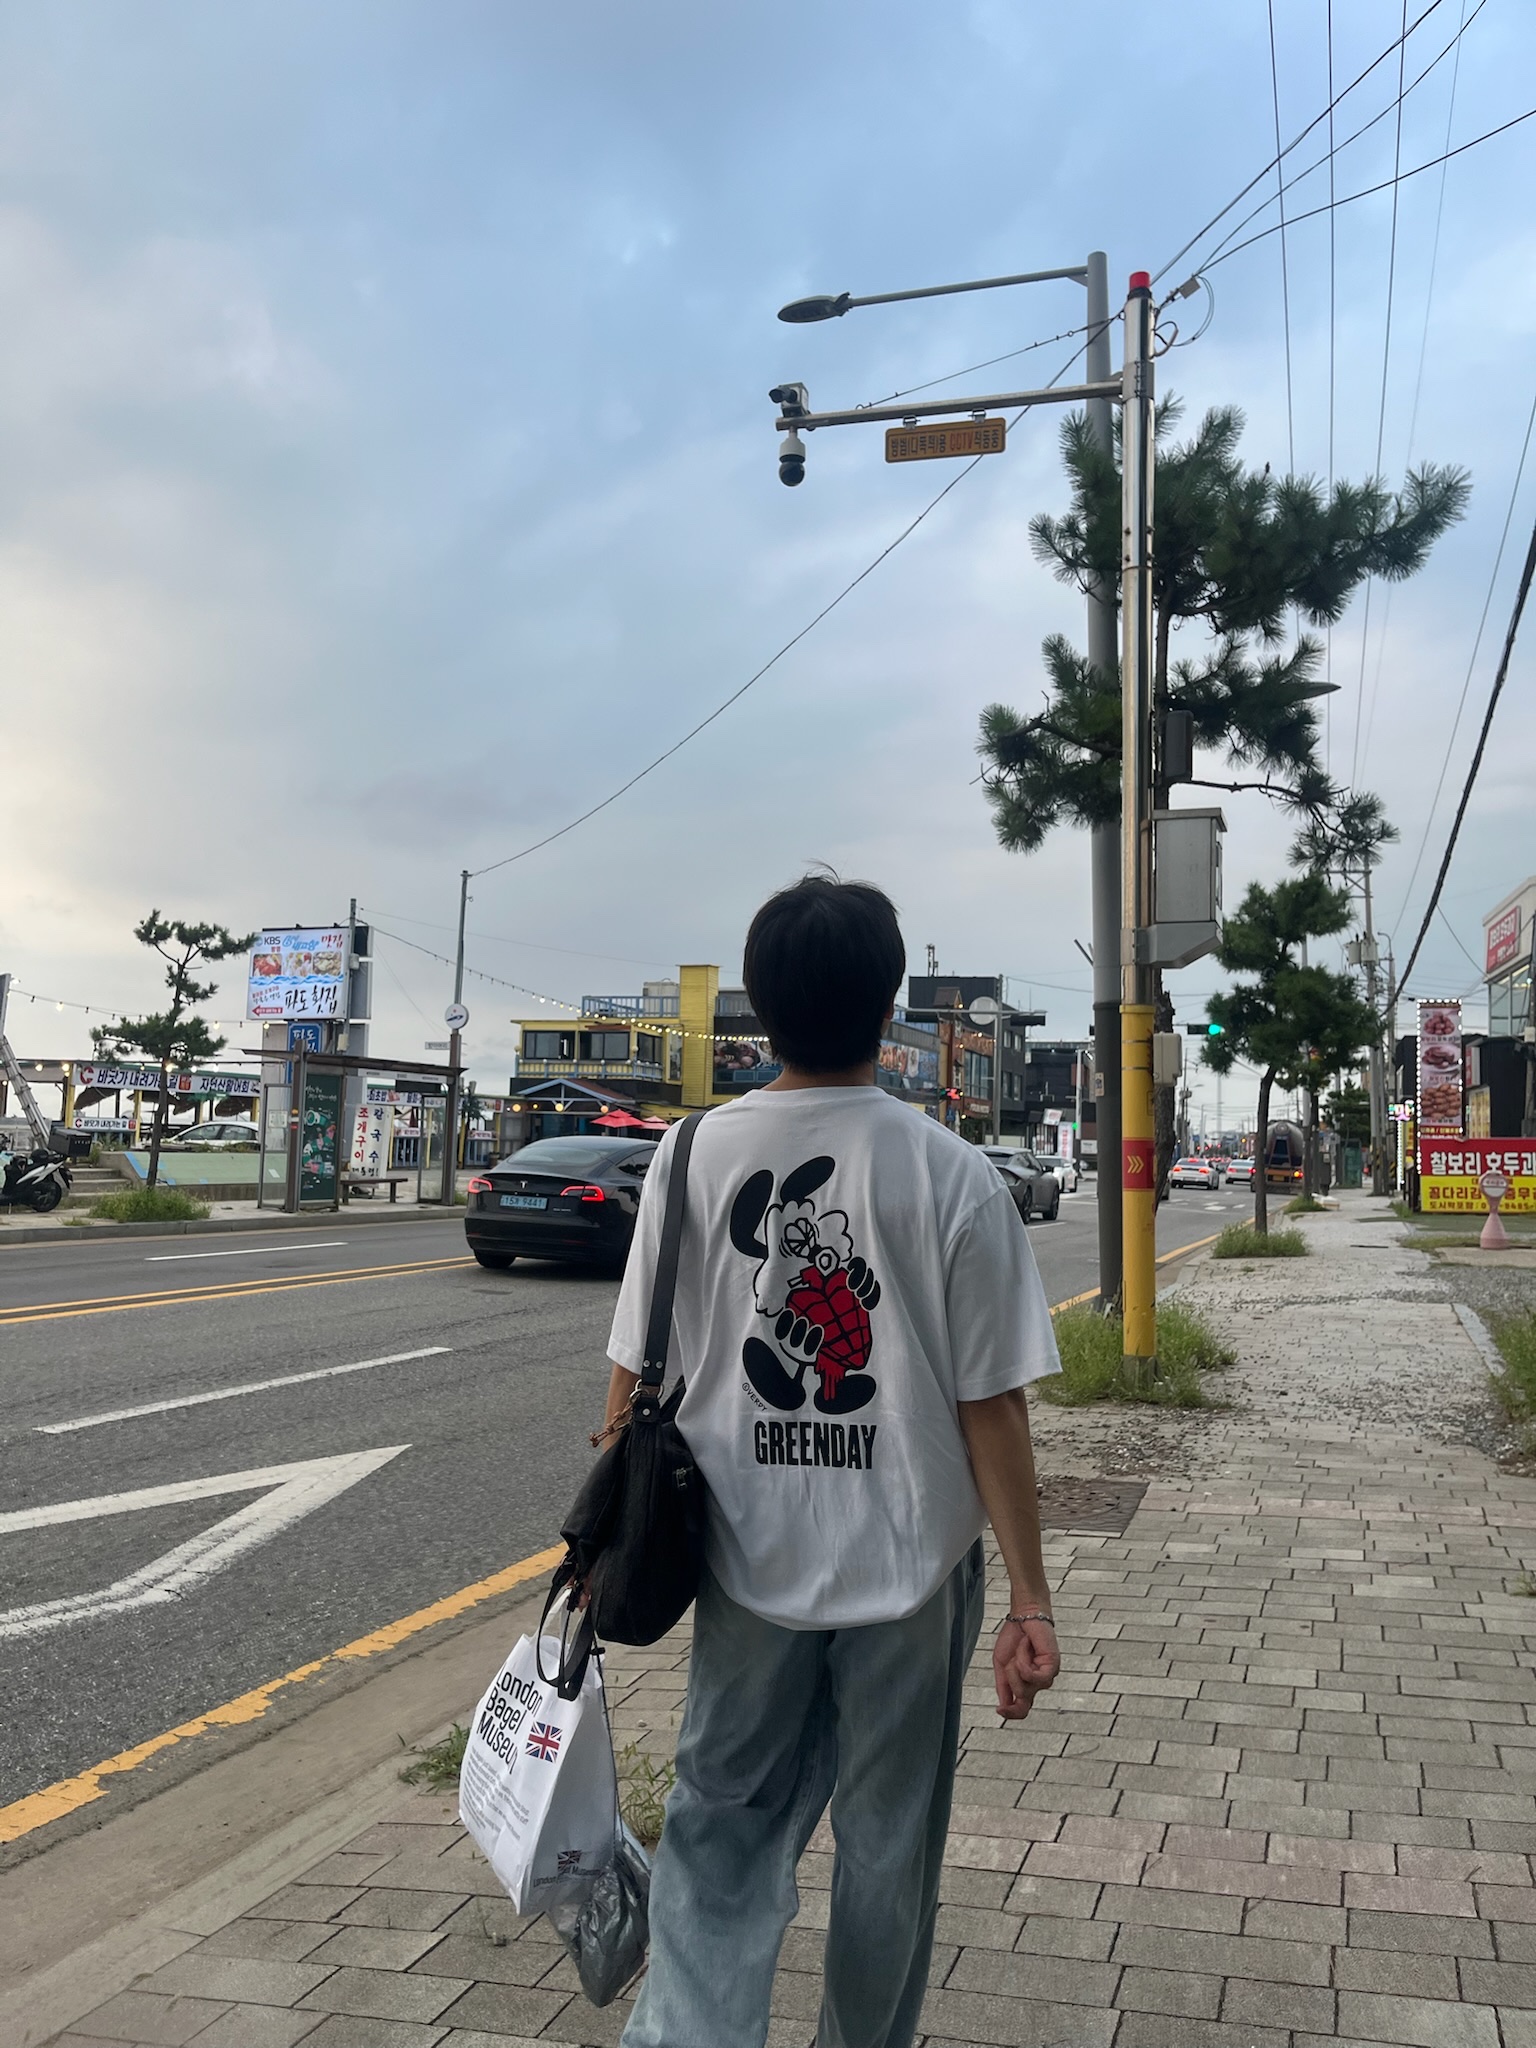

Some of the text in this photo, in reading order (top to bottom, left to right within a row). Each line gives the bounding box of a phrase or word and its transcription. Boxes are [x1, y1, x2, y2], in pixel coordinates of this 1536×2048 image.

[263, 936, 281, 945] KBS
[321, 934, 343, 949] 맛집
[284, 984, 337, 1014] 파도 횟집
[292, 1029, 317, 1041] 파도
[97, 1069, 129, 1086] 바닷가
[84, 1119, 100, 1128] 바닷가
[100, 1119, 121, 1128] 내려가는
[355, 1107, 369, 1162] 조개구이
[369, 1107, 384, 1163] 칼국수
[1430, 1151, 1481, 1176] 찰보리
[754, 1420, 877, 1470] GREENDAY
[497, 1663, 543, 1718] London
[486, 1686, 527, 1734] Bagel
